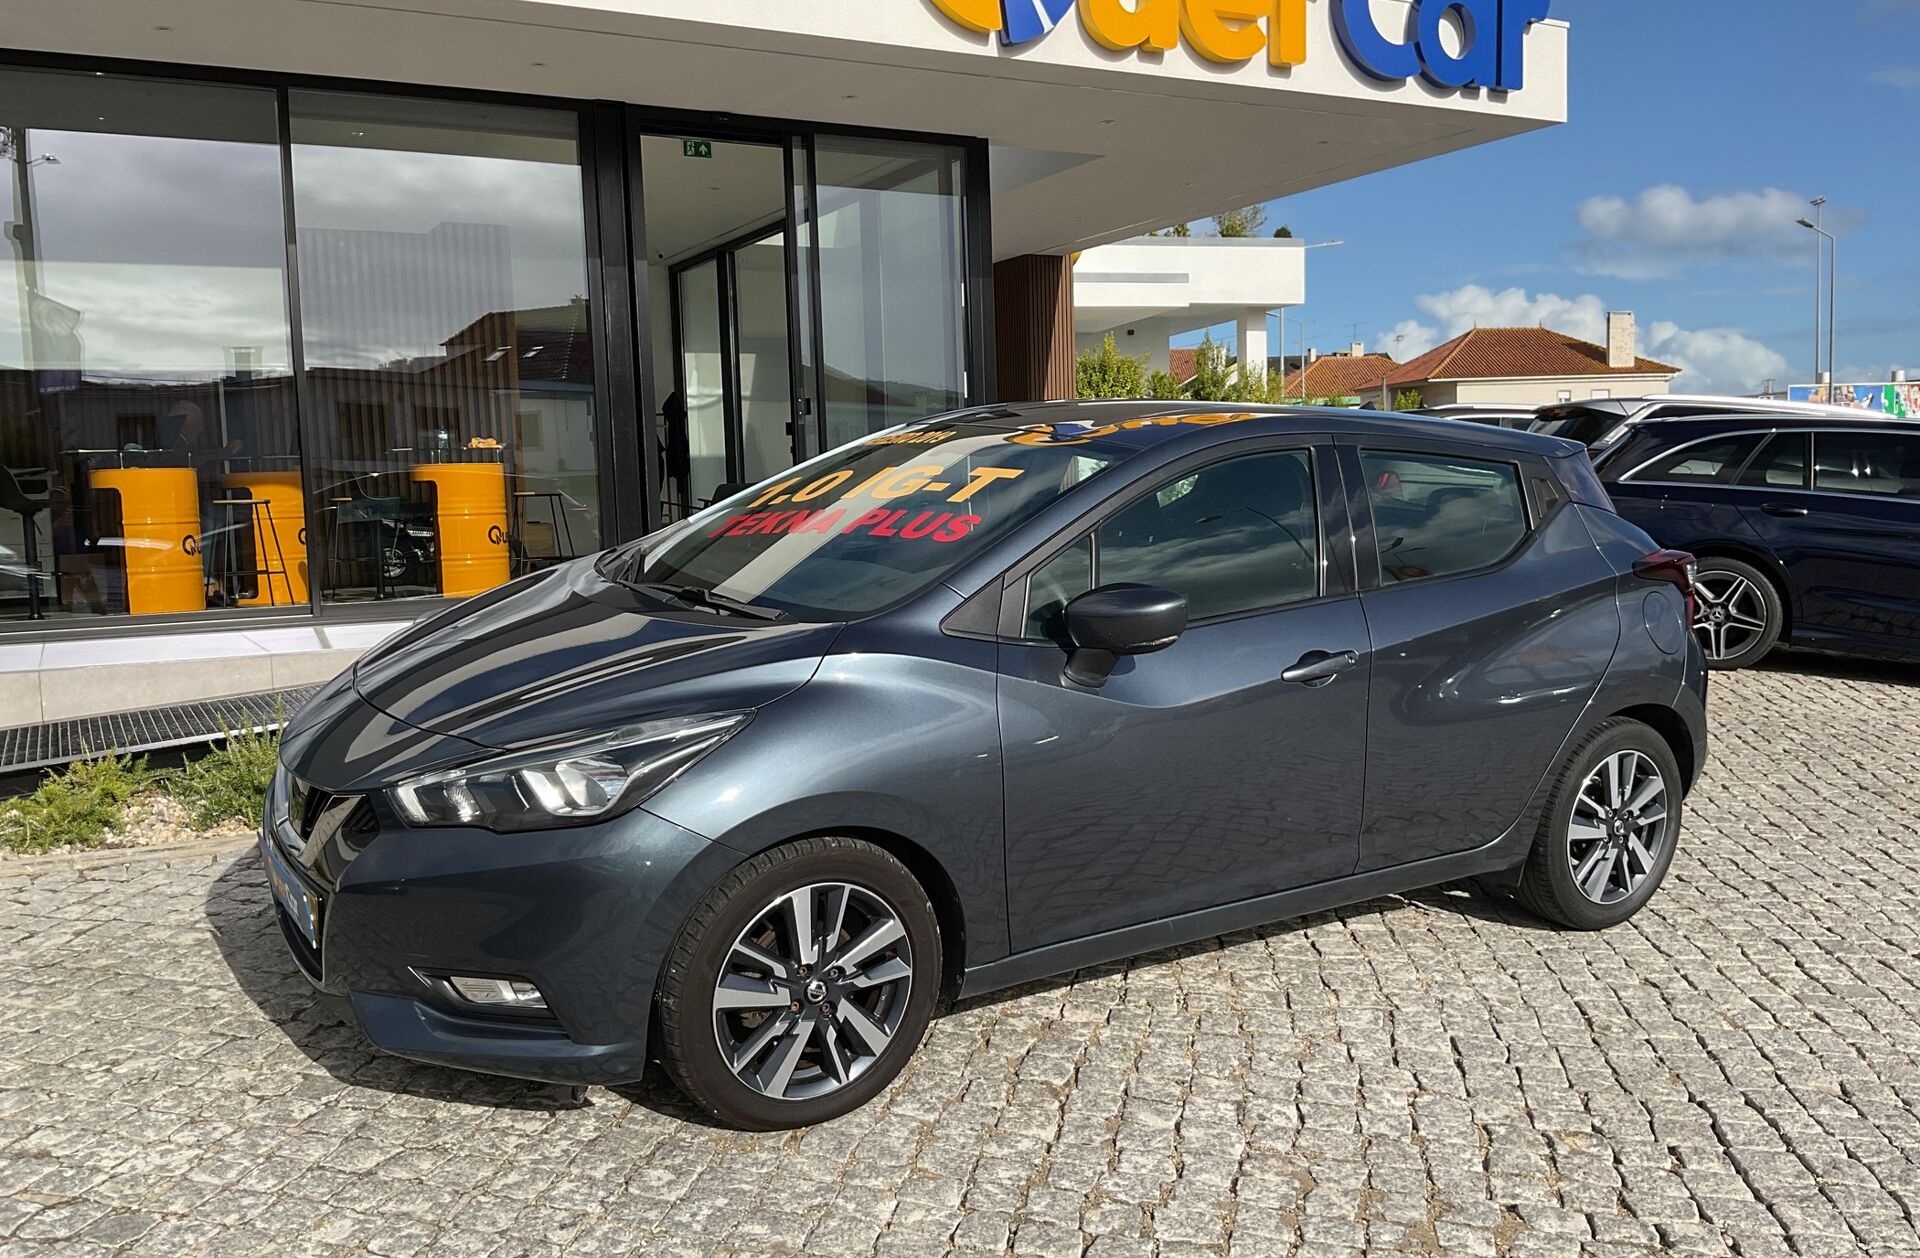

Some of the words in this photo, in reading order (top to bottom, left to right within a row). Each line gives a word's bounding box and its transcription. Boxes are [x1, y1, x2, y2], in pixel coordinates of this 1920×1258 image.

[746, 469, 855, 508] 1.0
[840, 465, 1026, 503] IG-T
[706, 507, 847, 539] TEKNA
[842, 508, 983, 543] PLUS
